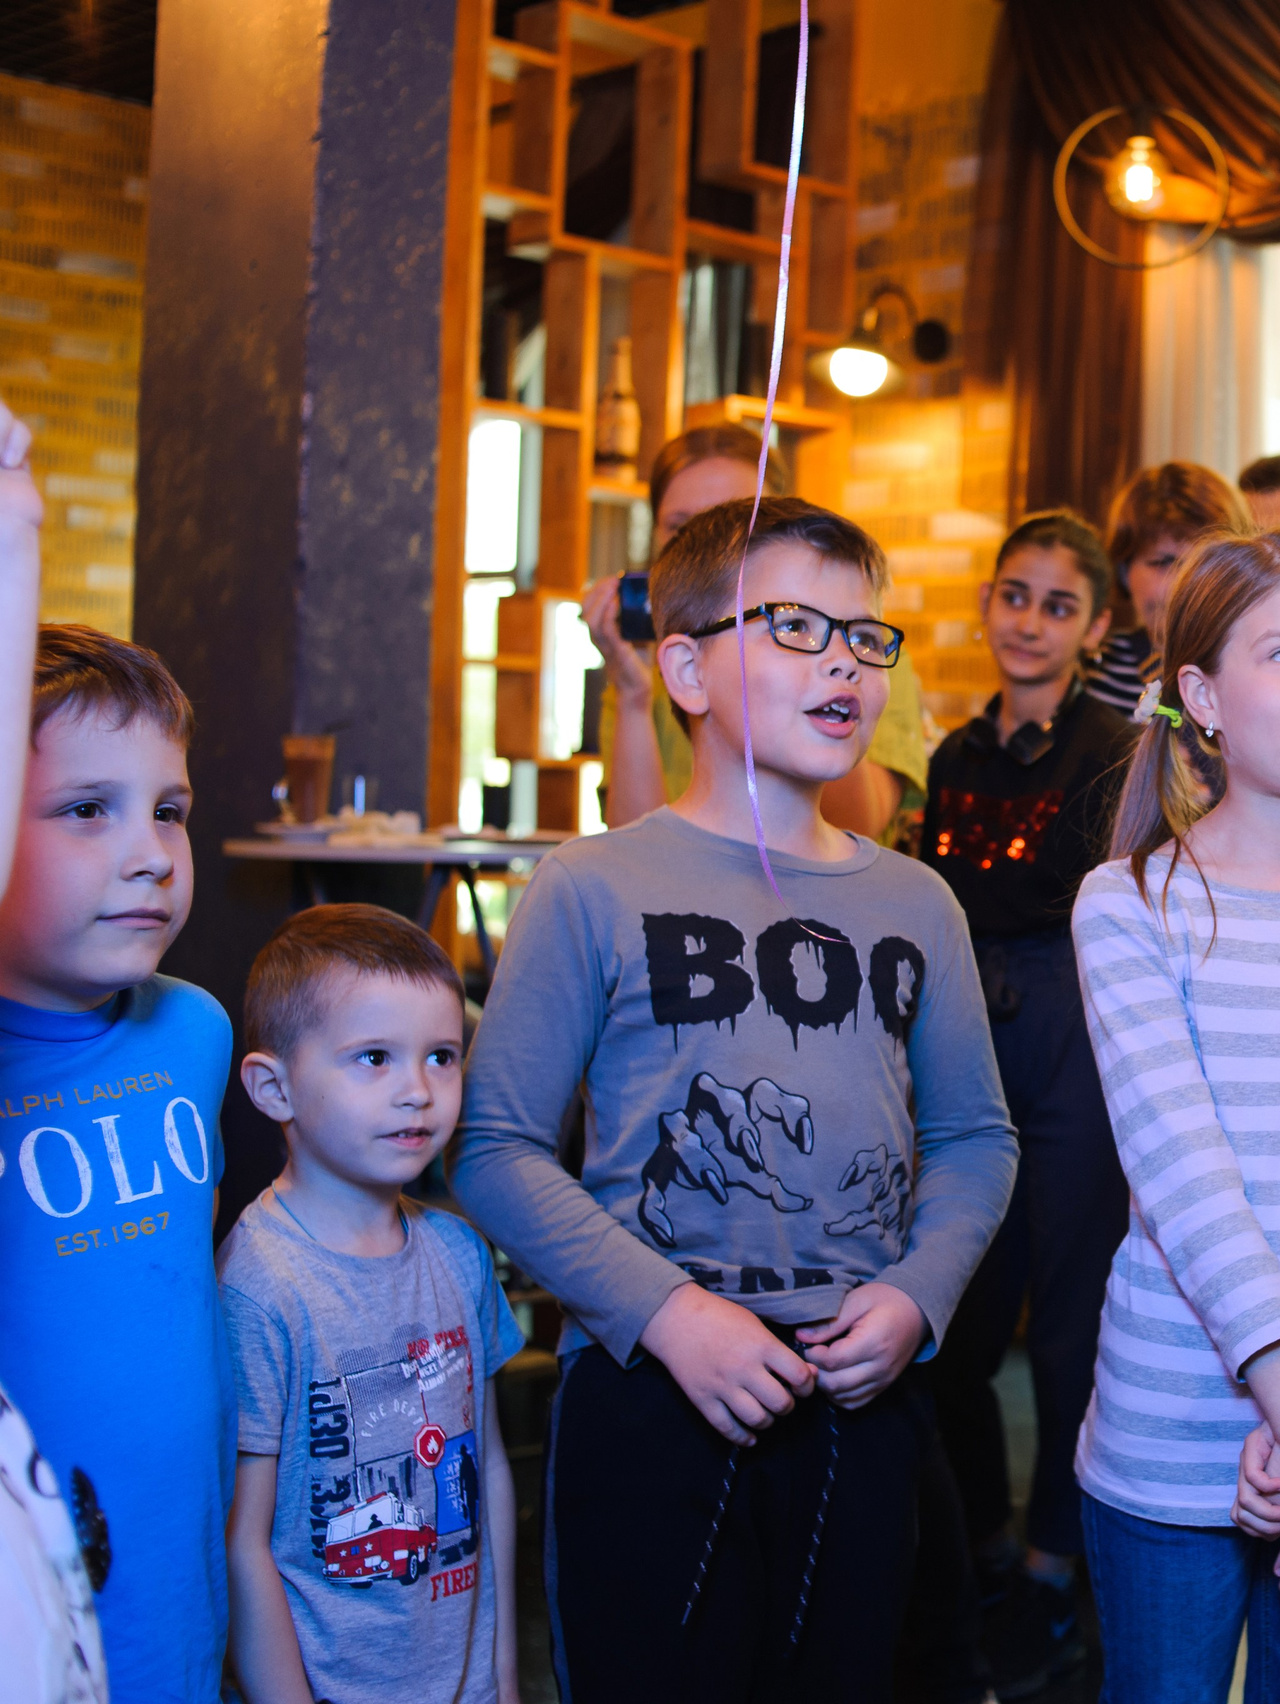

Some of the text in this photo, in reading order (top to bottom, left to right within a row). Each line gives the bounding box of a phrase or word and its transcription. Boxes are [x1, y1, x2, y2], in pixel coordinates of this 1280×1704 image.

[73, 1070, 174, 1106] LAUREN
[0, 1096, 209, 1219] OLO
[361, 1402, 388, 1438] FIRE
